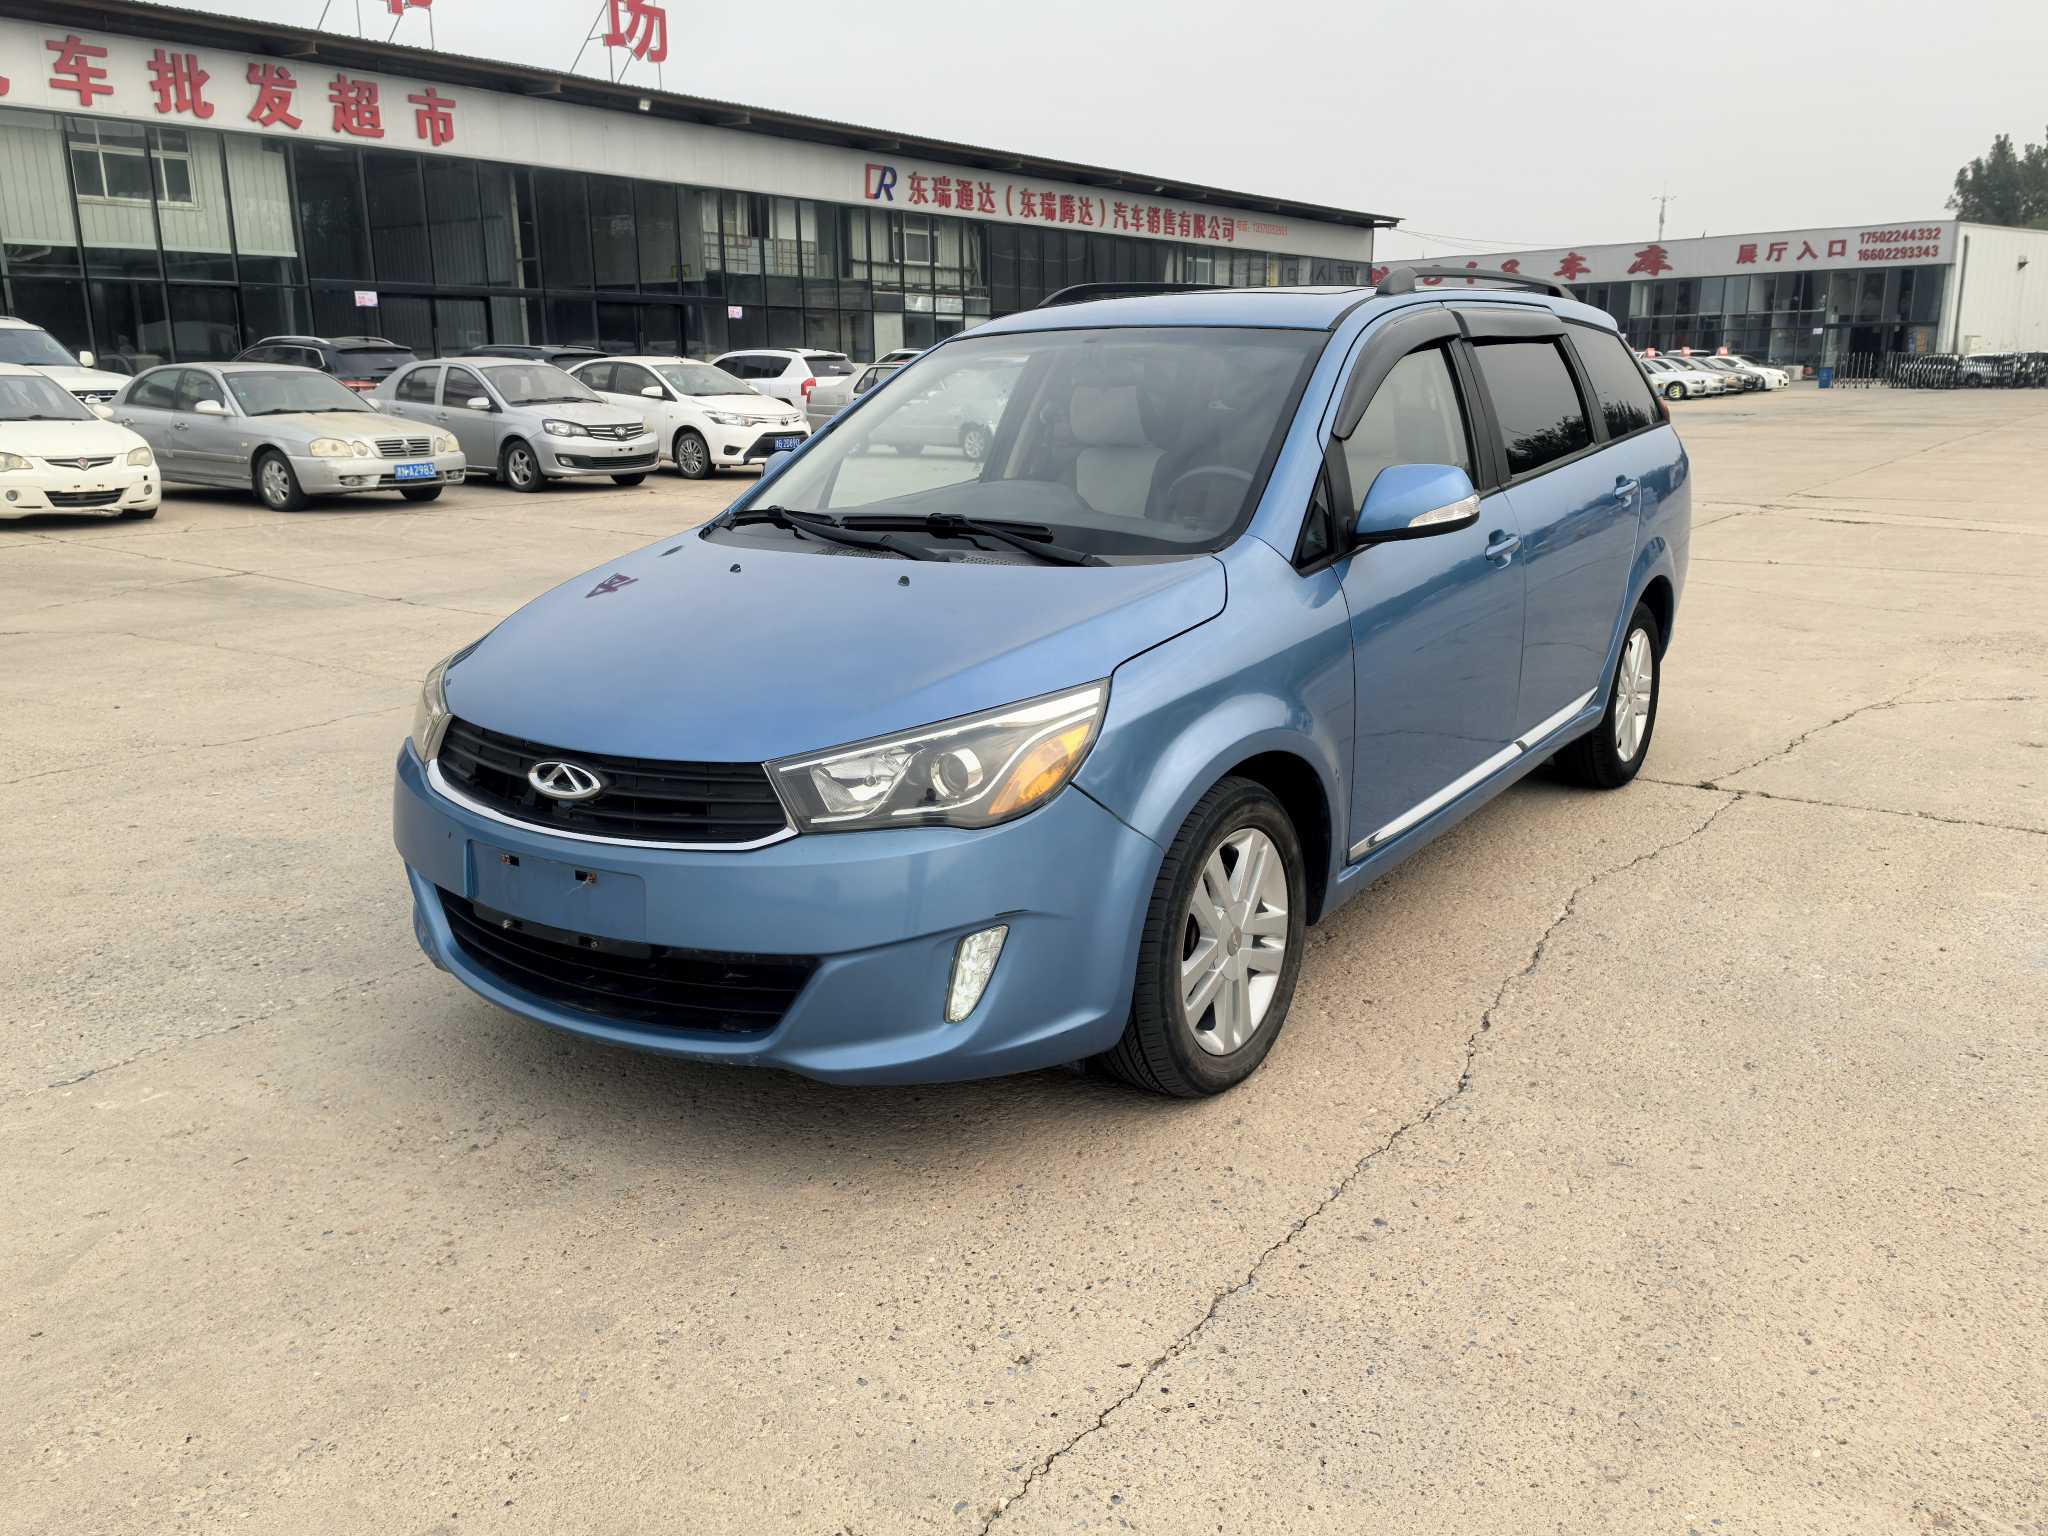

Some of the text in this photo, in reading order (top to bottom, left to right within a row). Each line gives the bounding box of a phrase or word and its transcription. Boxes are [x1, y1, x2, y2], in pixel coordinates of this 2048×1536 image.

[0, 34, 456, 146] 车批发超市
[1859, 227, 1942, 244] 17502244332
[1736, 239, 1847, 264] 展厅入口
[1857, 245, 1939, 261] 16602293343
